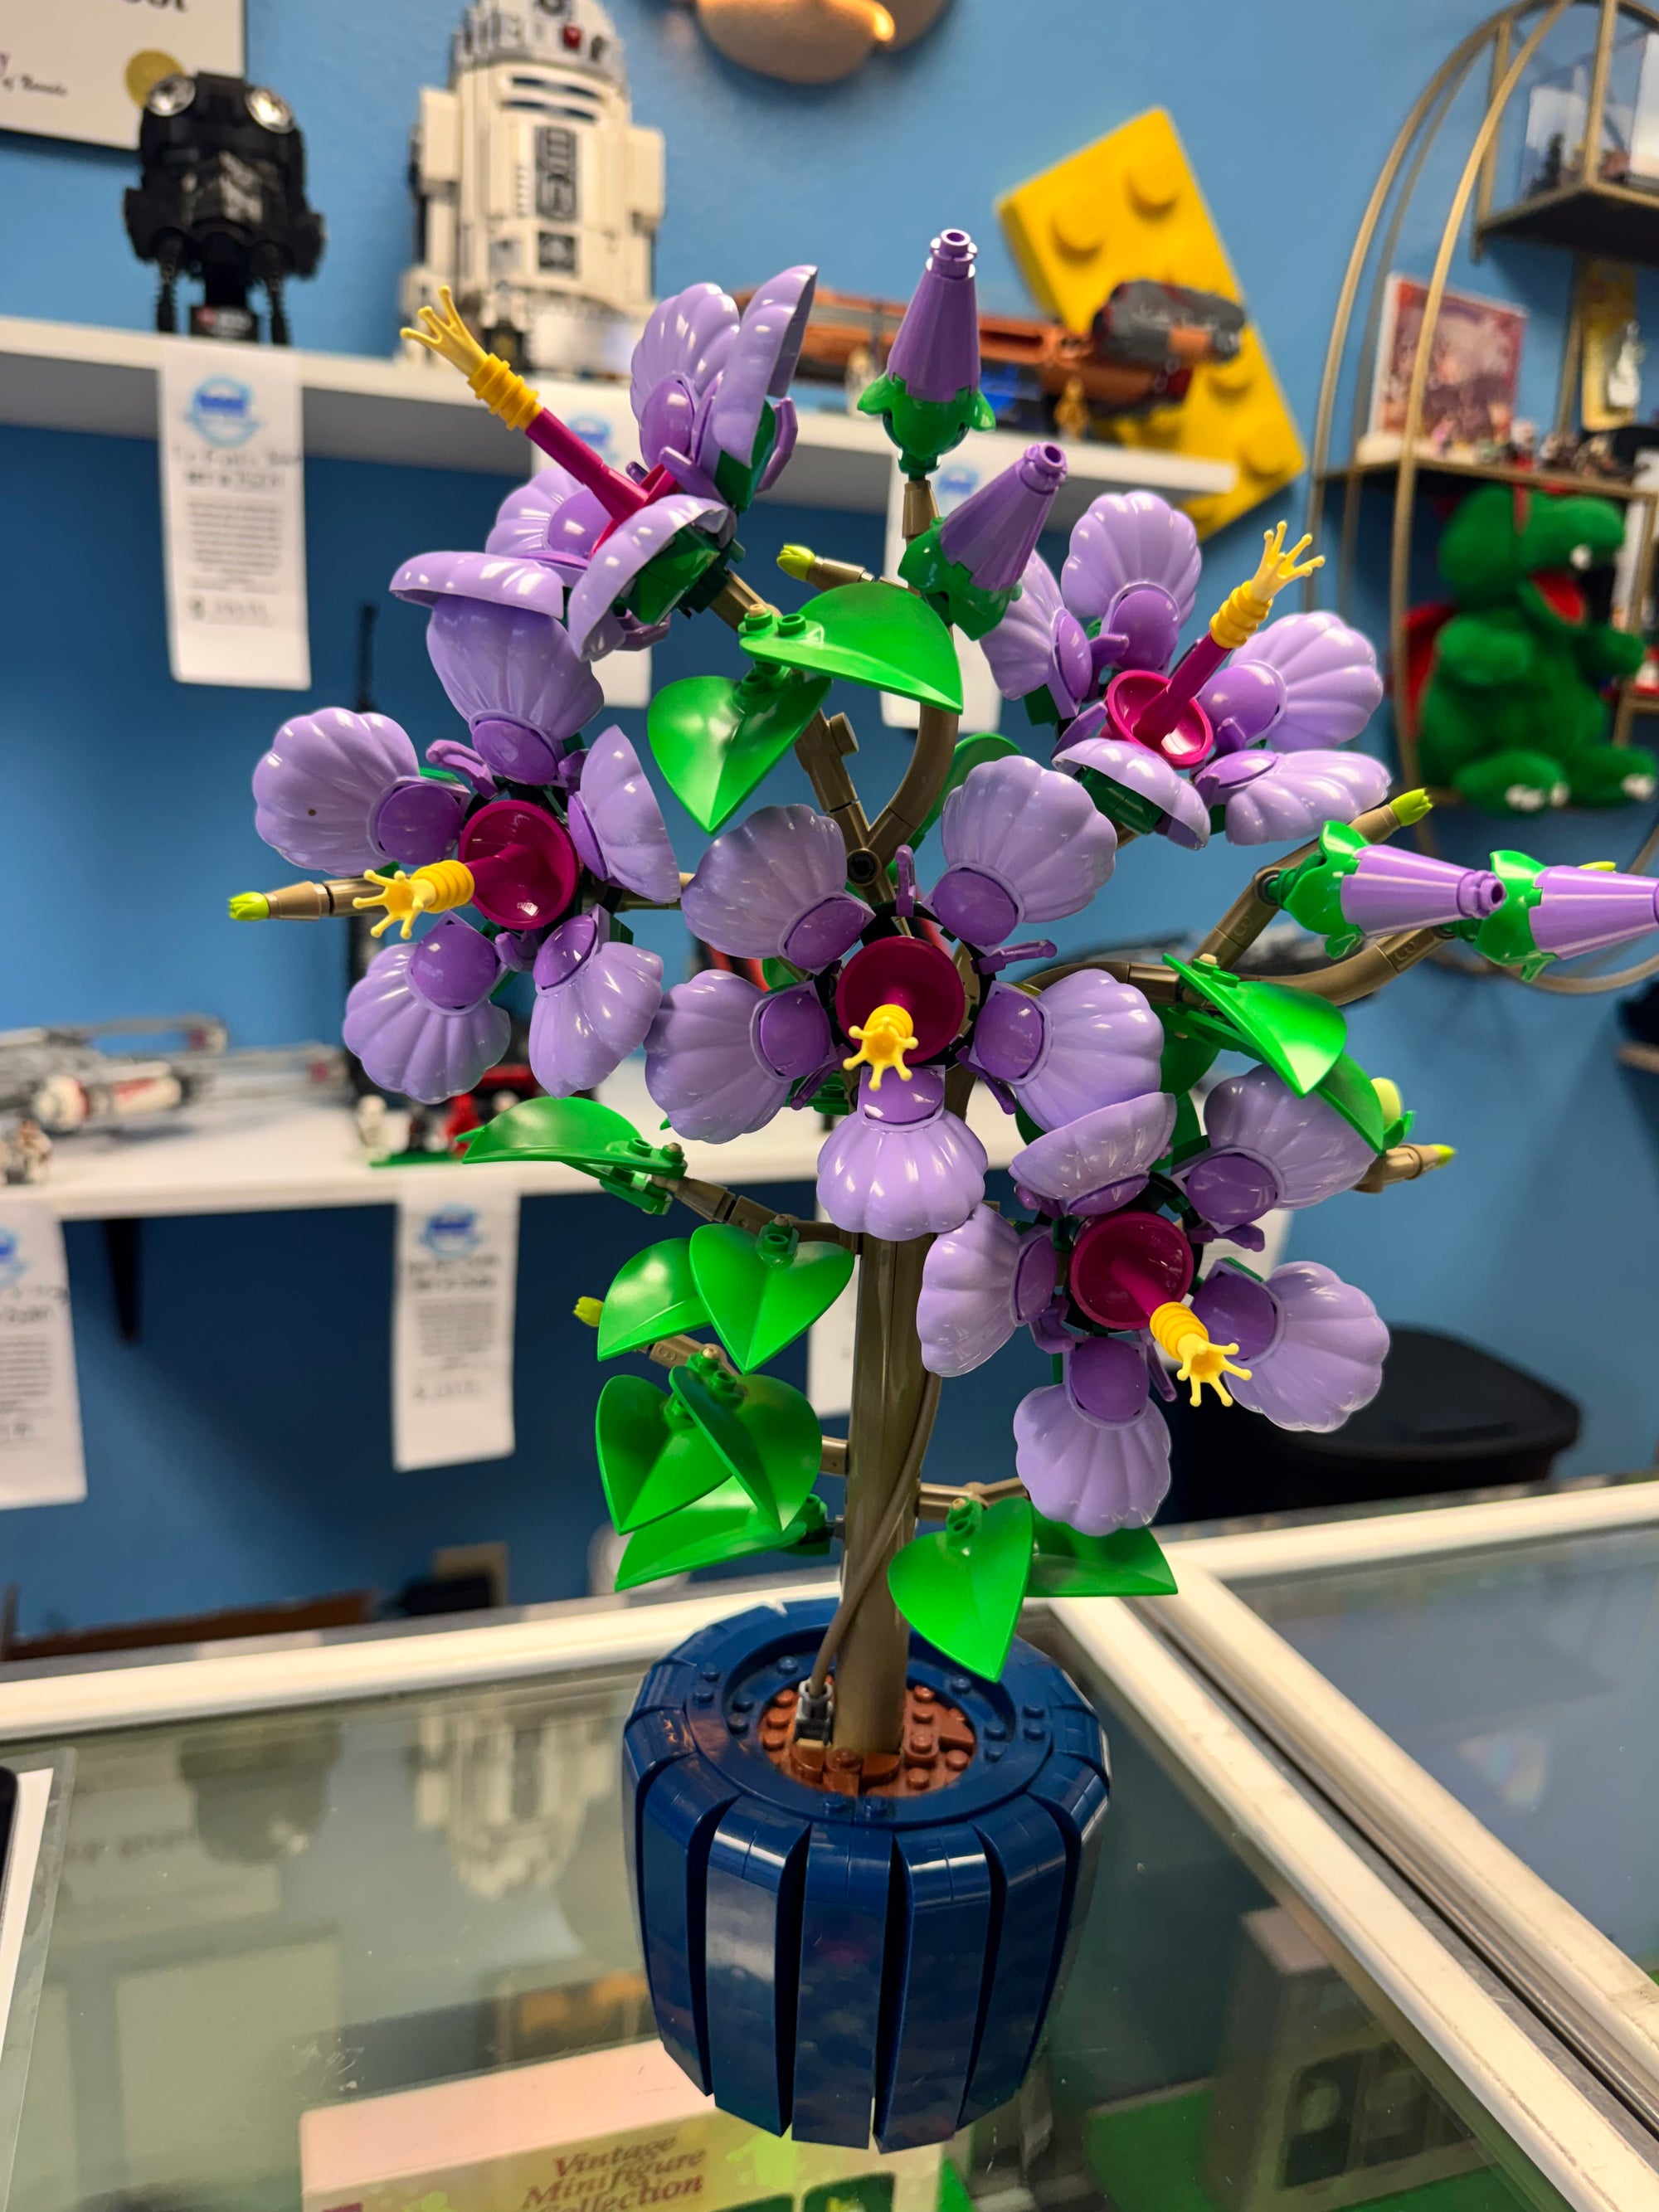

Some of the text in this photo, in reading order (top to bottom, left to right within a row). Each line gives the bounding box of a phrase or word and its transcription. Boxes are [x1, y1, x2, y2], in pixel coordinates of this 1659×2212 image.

[553, 2136, 678, 2177] Vintage
[520, 2148, 706, 2210] Minifigure
[539, 2175, 704, 2212] llection
